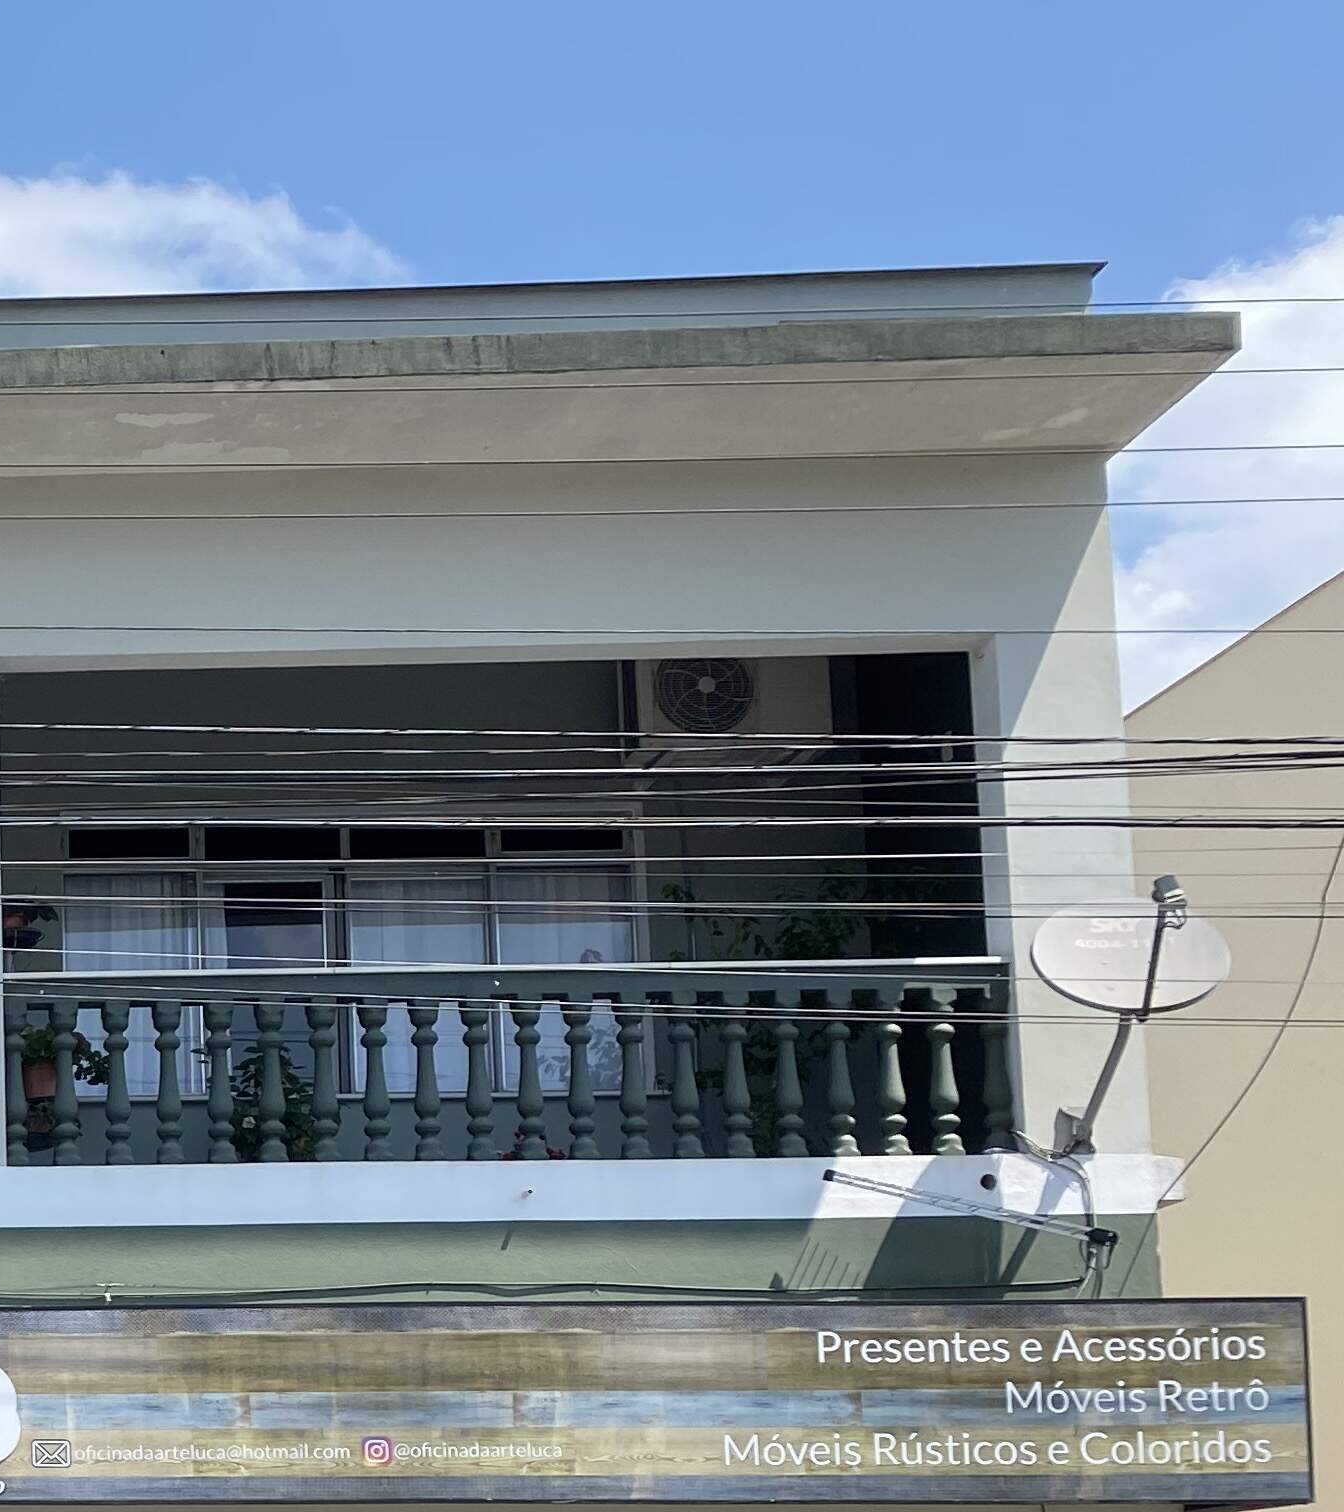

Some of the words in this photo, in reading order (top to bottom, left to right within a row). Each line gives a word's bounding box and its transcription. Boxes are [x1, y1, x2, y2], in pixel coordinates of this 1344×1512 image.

[816, 1330, 1010, 1364] Presentes
[1019, 1337, 1043, 1362] e
[1052, 1327, 1267, 1362] Acessórios
[1004, 1379, 1147, 1415] Móveis
[1158, 1378, 1270, 1413] Retrô
[74, 1443, 352, 1461] oficinadaarteluca@hotmail.com
[394, 1442, 563, 1461] @oficinadaarteluca
[723, 1432, 863, 1467] Móveis
[873, 1431, 1037, 1466] Rústicos
[1046, 1440, 1069, 1464] e
[1078, 1430, 1272, 1465] Coloridos
